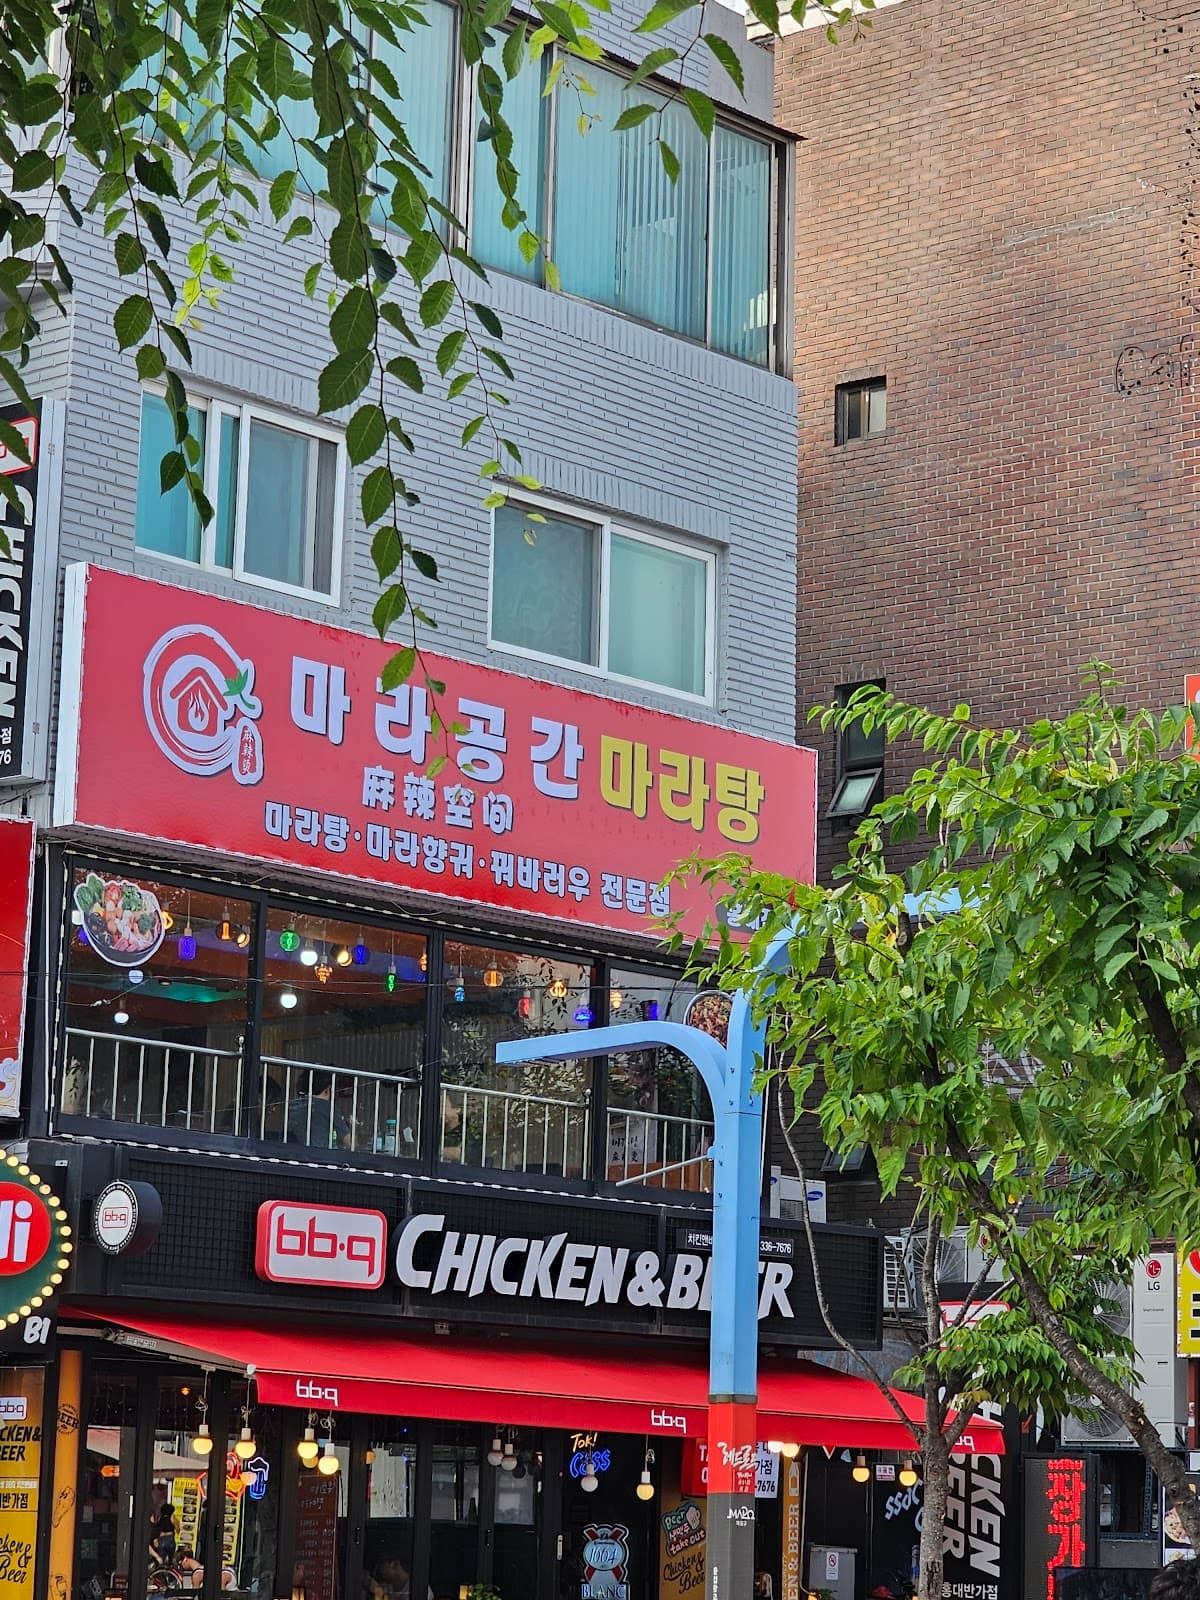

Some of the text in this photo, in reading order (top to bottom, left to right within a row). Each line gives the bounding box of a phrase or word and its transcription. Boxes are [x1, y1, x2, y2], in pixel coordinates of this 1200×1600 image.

[291, 655, 765, 843] 마라공간 마라탕
[600, 873, 671, 916] 전문점
[1147, 1281, 1161, 1291] LG
[0, 1445, 26, 1462] EER
[0, 1492, 29, 1509] 반가점
[787, 1503, 800, 1554] BEER
[669, 1529, 705, 1555] take out
[582, 1583, 626, 1599] BLANC
[941, 1582, 999, 1600] 홍대반가점
